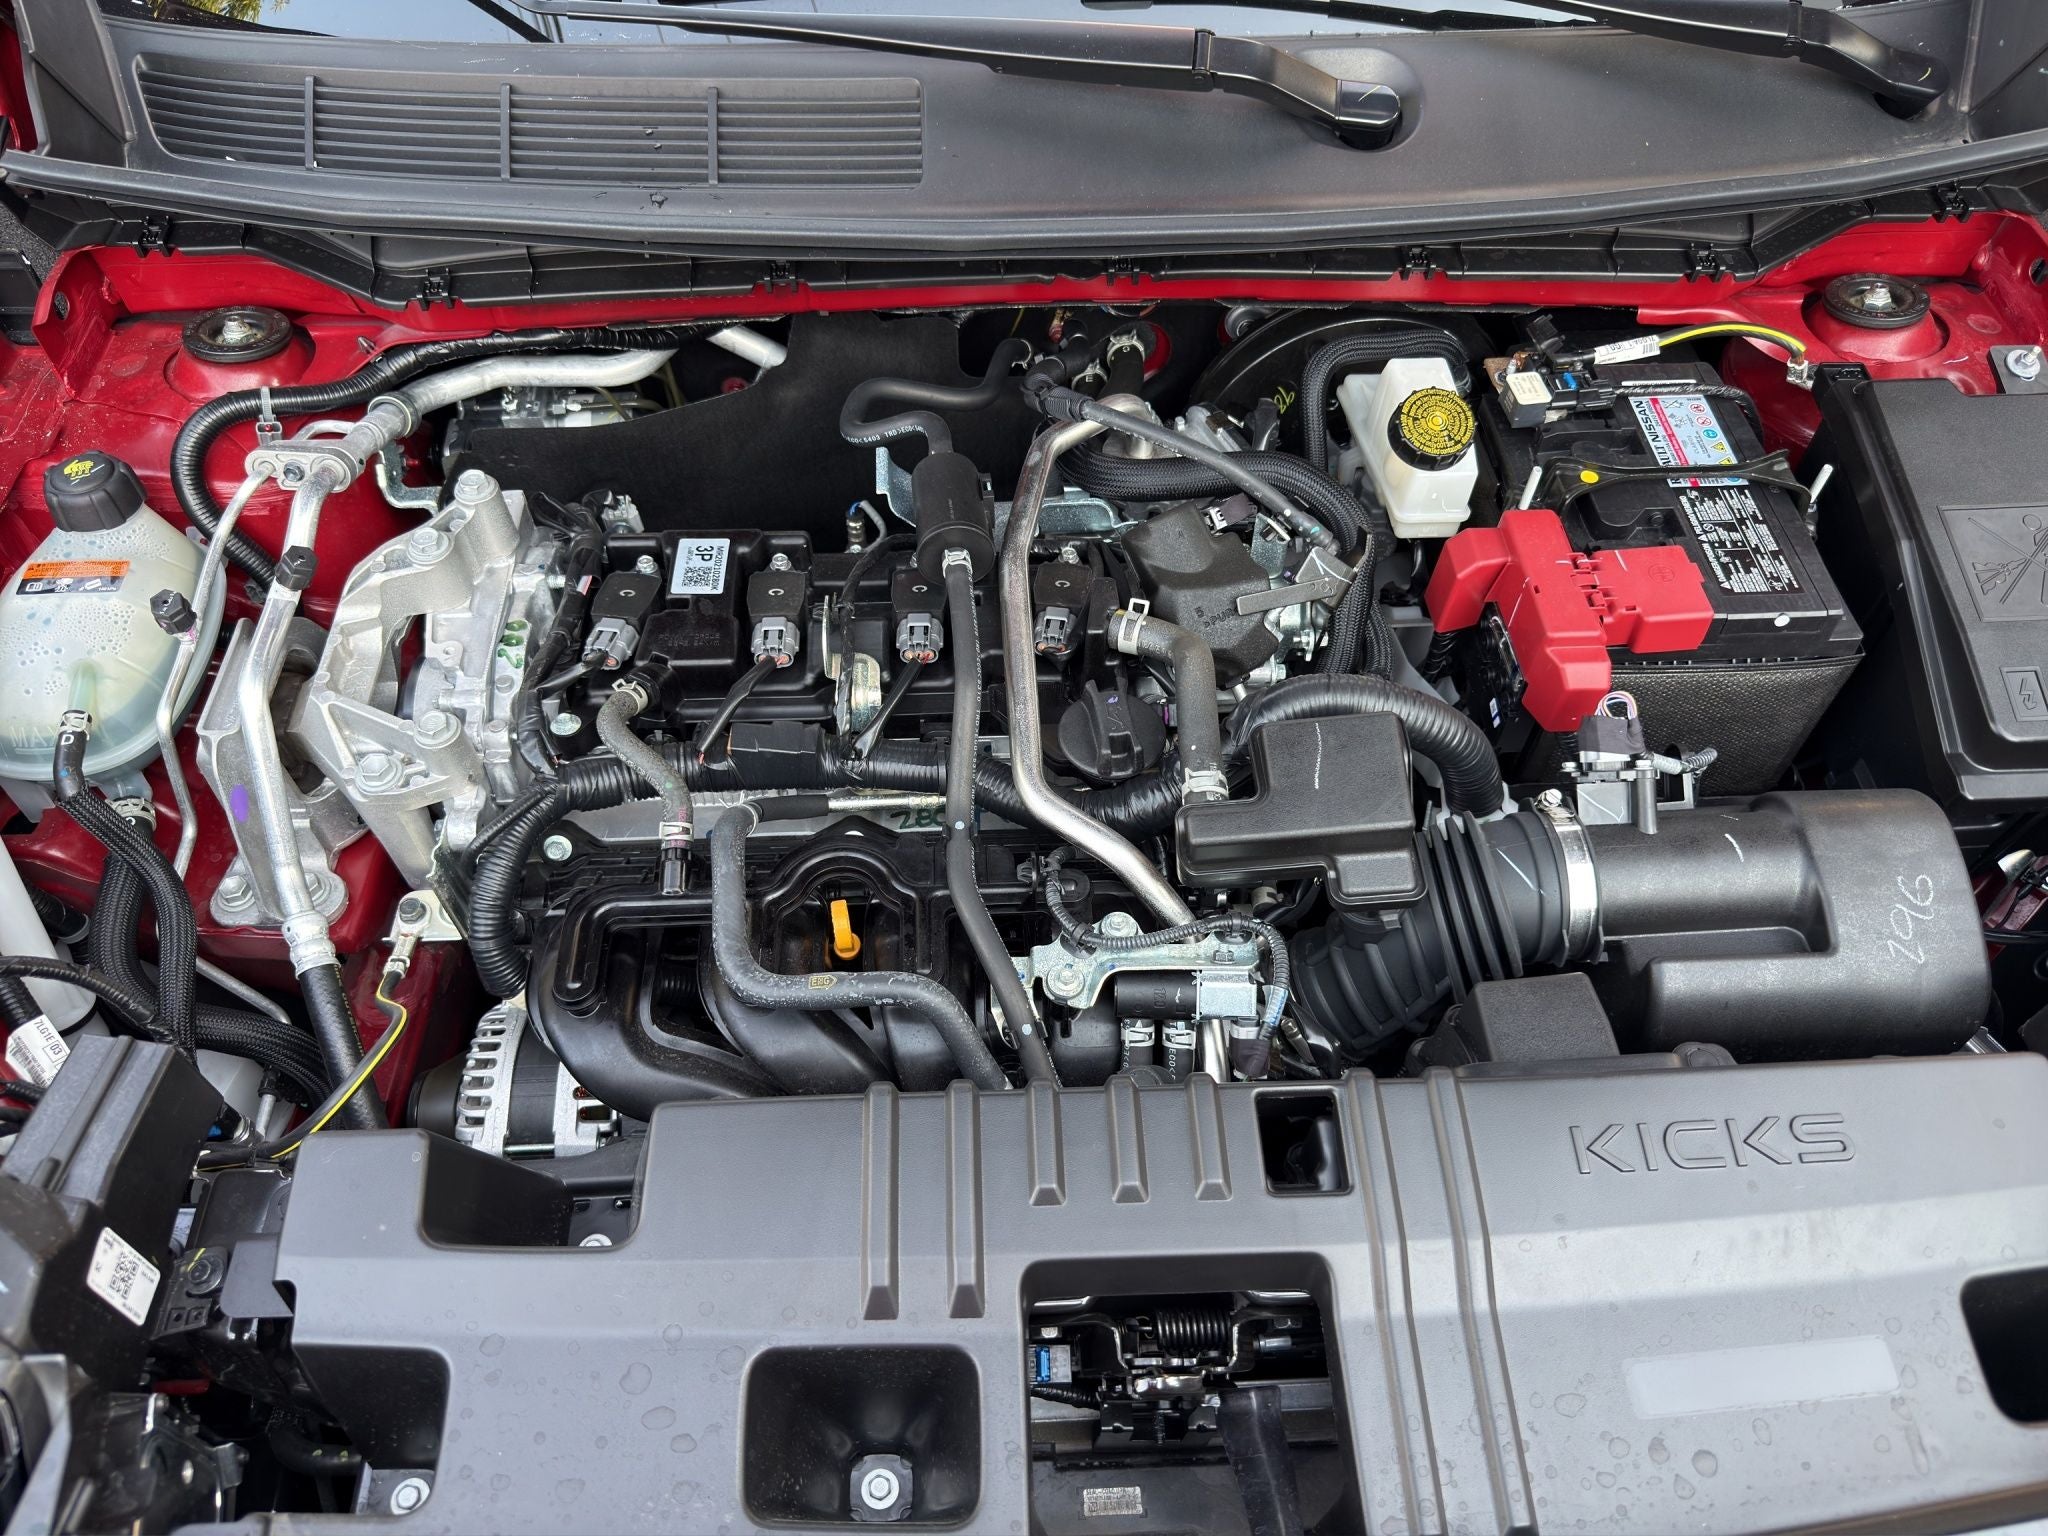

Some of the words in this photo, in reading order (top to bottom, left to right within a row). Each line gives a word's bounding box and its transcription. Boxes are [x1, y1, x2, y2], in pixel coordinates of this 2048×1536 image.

[1634, 400, 1660, 442] NISSAN
[694, 546, 714, 562] 3P
[61, 734, 74, 746] D
[812, 977, 830, 986] ENG
[50, 1043, 62, 1056] 03
[1570, 1113, 1857, 1174] KICKS
